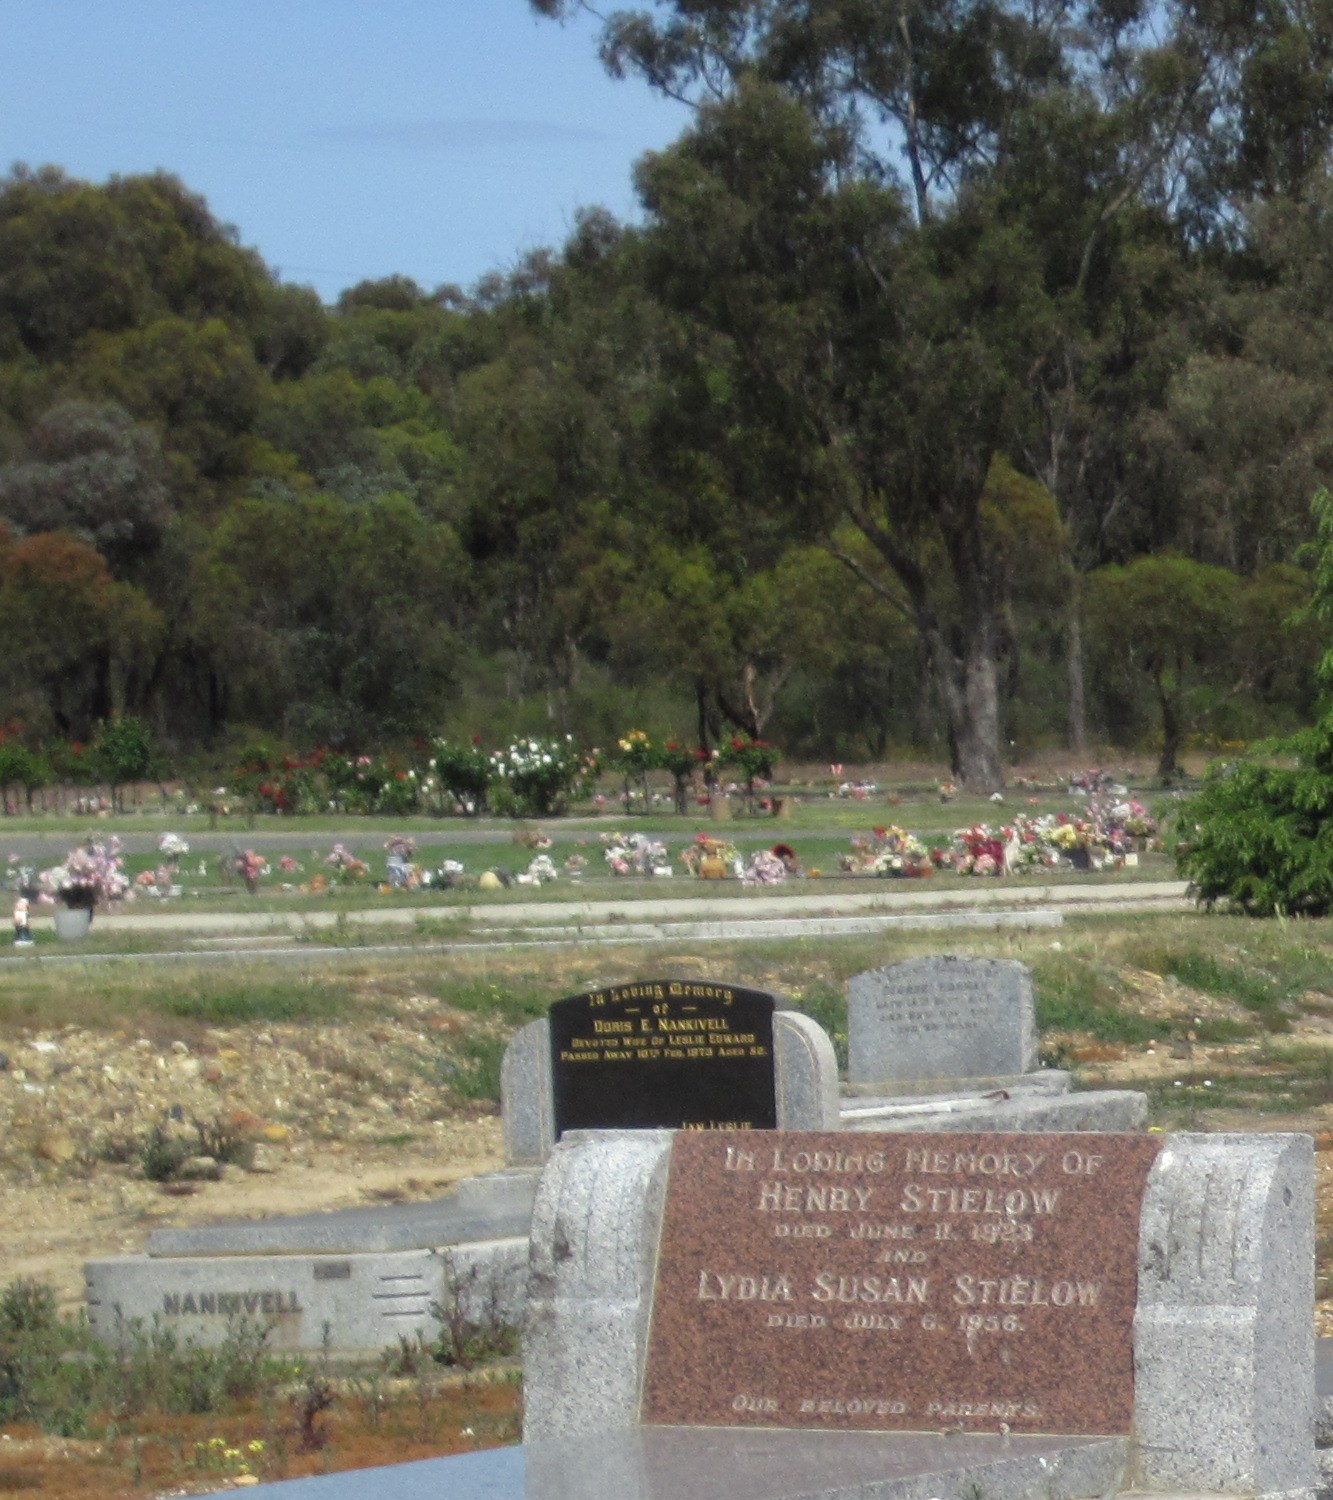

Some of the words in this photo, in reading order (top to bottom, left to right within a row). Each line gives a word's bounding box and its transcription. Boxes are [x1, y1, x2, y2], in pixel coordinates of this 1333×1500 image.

[593, 1020, 632, 1032] DORIS
[724, 1147, 755, 1172] IN
[905, 1150, 1045, 1177] MEMORY
[1063, 1152, 1103, 1175] OF
[758, 1182, 874, 1213] HENRY
[900, 1184, 1060, 1215] STIELOW
[776, 1224, 831, 1238] DIED
[851, 1224, 914, 1239] JUNE
[876, 1251, 928, 1262] AND
[698, 1269, 791, 1302] LYDIA
[812, 1273, 929, 1303] SUSAN
[953, 1275, 1102, 1306] STIELOW
[768, 1314, 828, 1327] DIED
[846, 1314, 900, 1330] JULY
[731, 1395, 778, 1411] OUR
[801, 1400, 907, 1414] BELOVED
